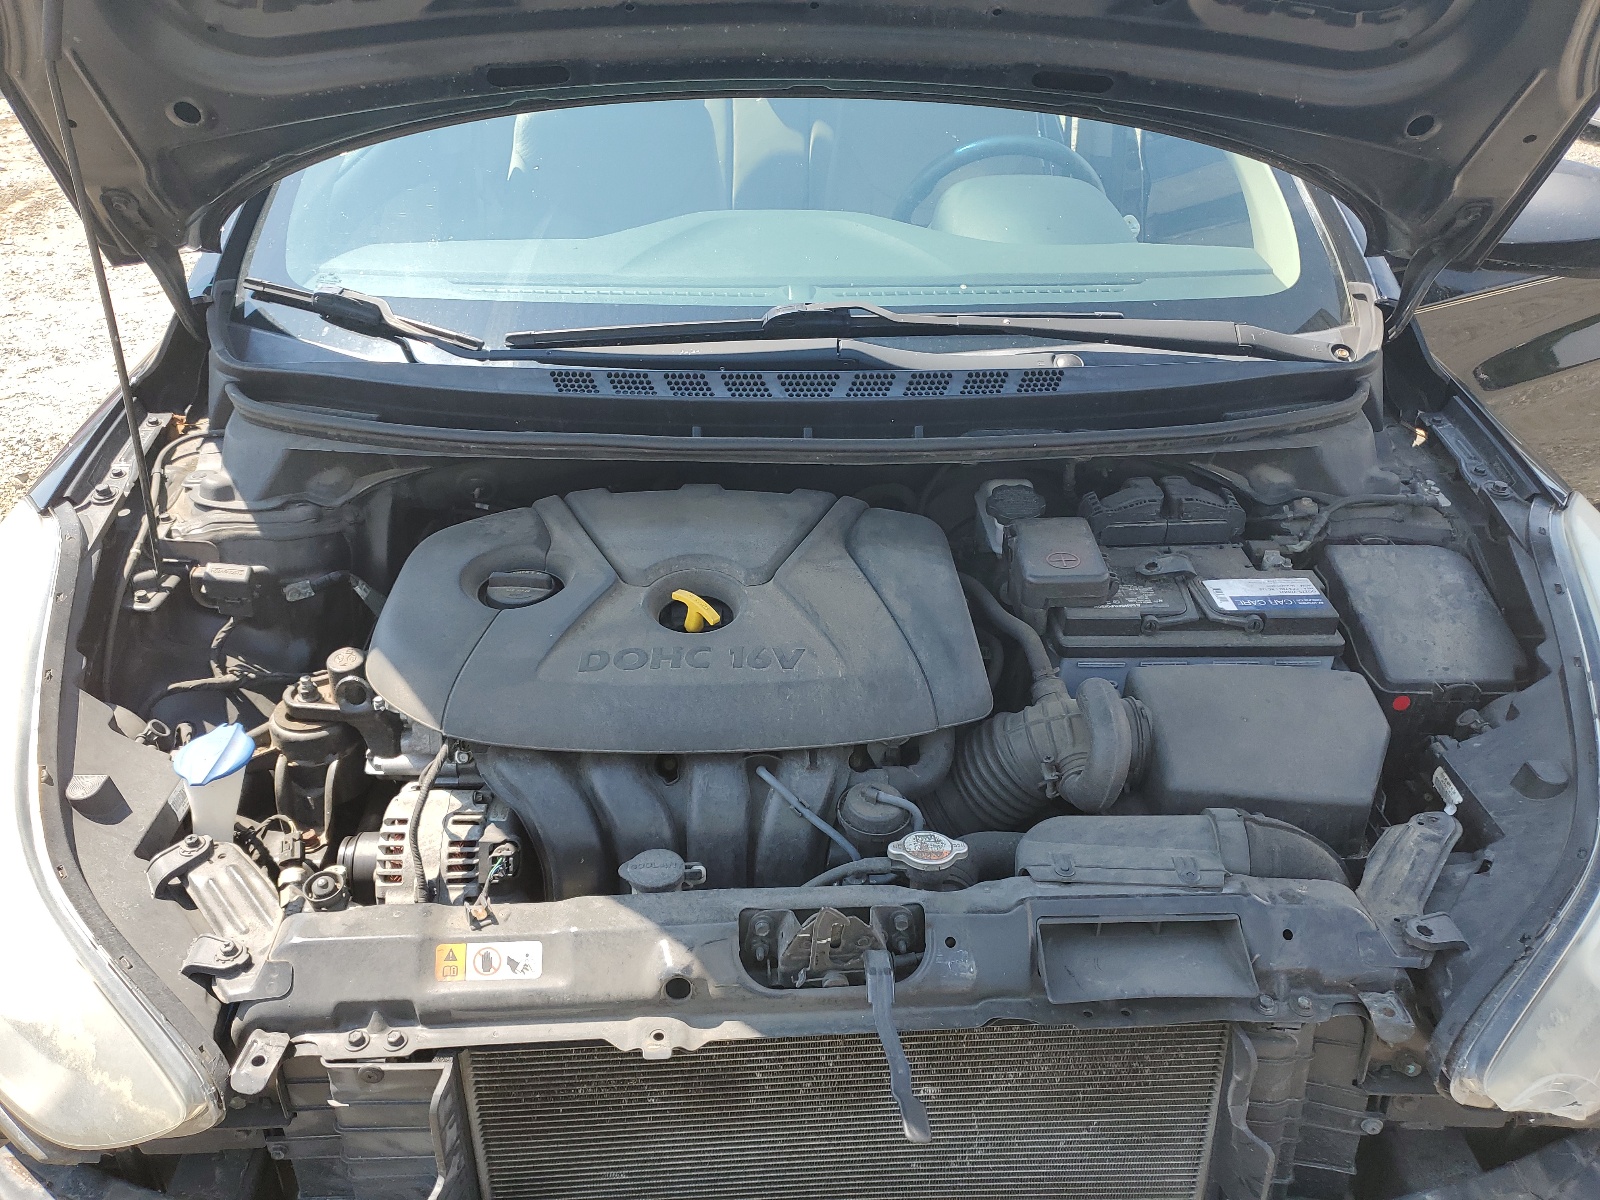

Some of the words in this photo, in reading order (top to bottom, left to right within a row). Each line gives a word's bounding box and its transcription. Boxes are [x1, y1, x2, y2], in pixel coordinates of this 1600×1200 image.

[1234, 598, 1266, 606] CARE
[578, 646, 712, 672] DOHC
[729, 646, 806, 670] 16V
